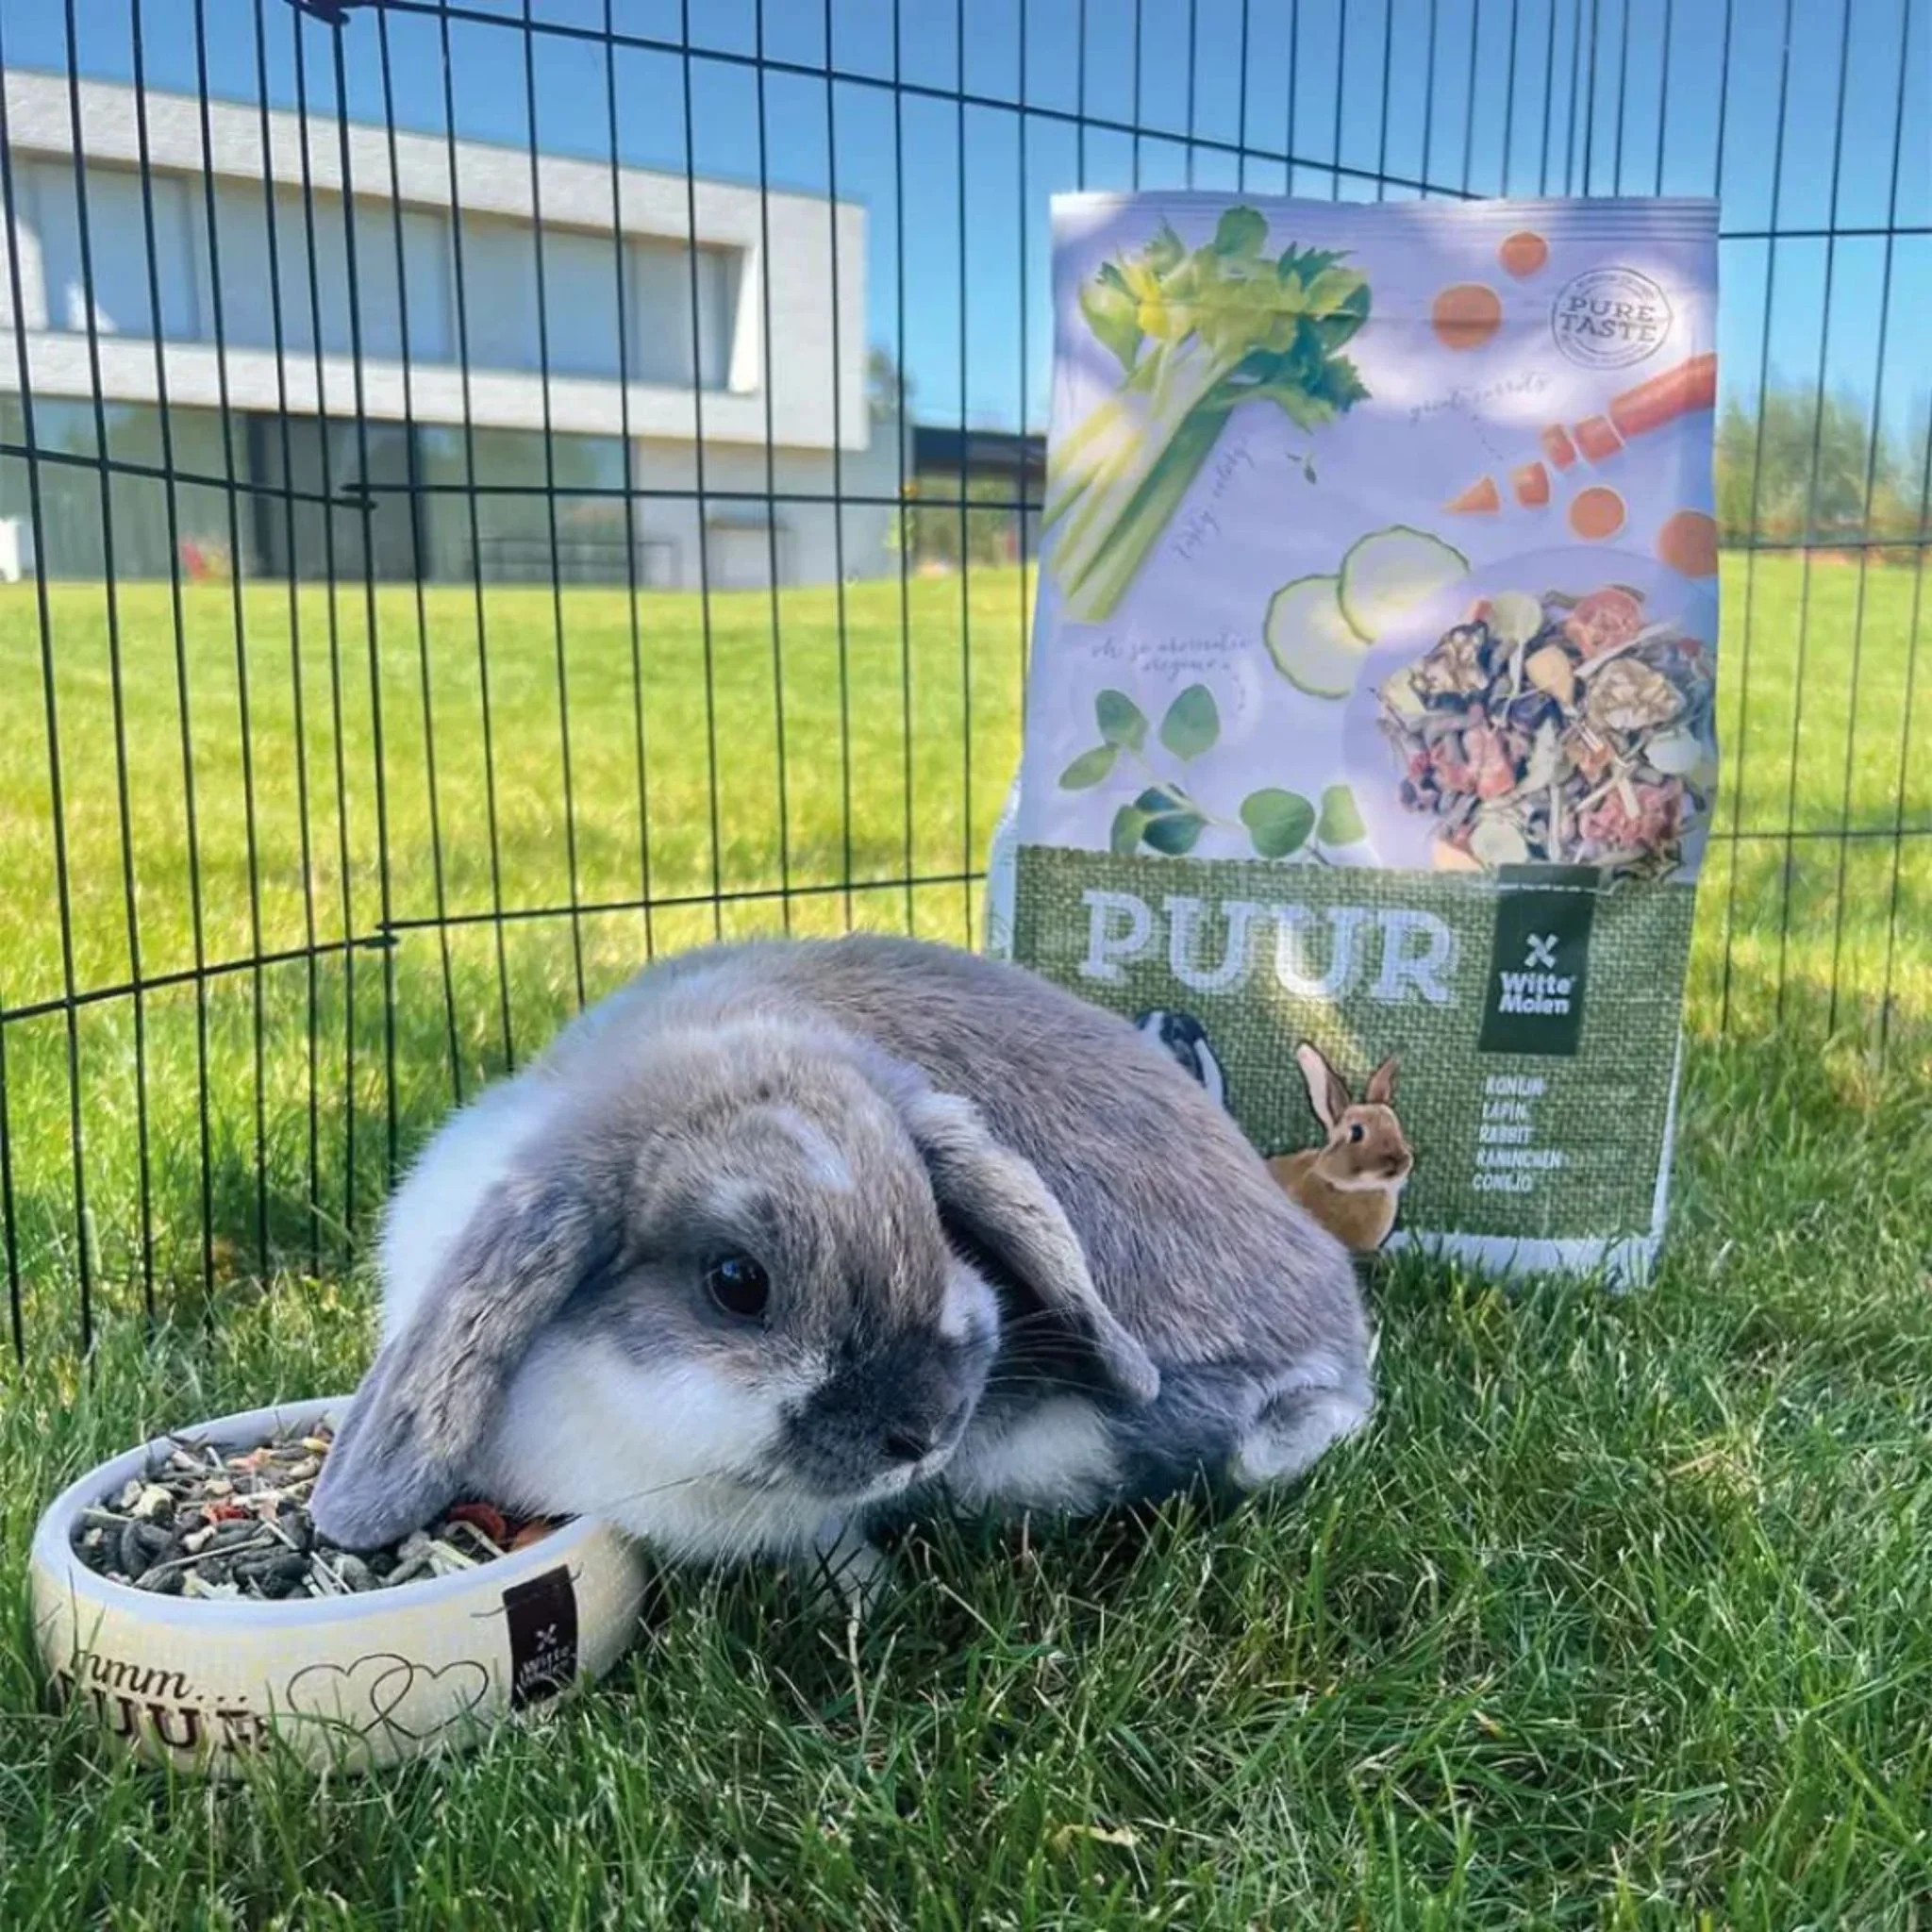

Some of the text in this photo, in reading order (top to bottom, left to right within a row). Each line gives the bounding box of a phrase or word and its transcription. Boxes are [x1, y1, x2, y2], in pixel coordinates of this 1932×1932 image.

[1566, 295, 1656, 322] PURE
[1559, 312, 1657, 342] TASTE
[1075, 889, 1461, 1007] PUUR
[1499, 972, 1572, 995] Witte
[1498, 993, 1570, 1014] Molen
